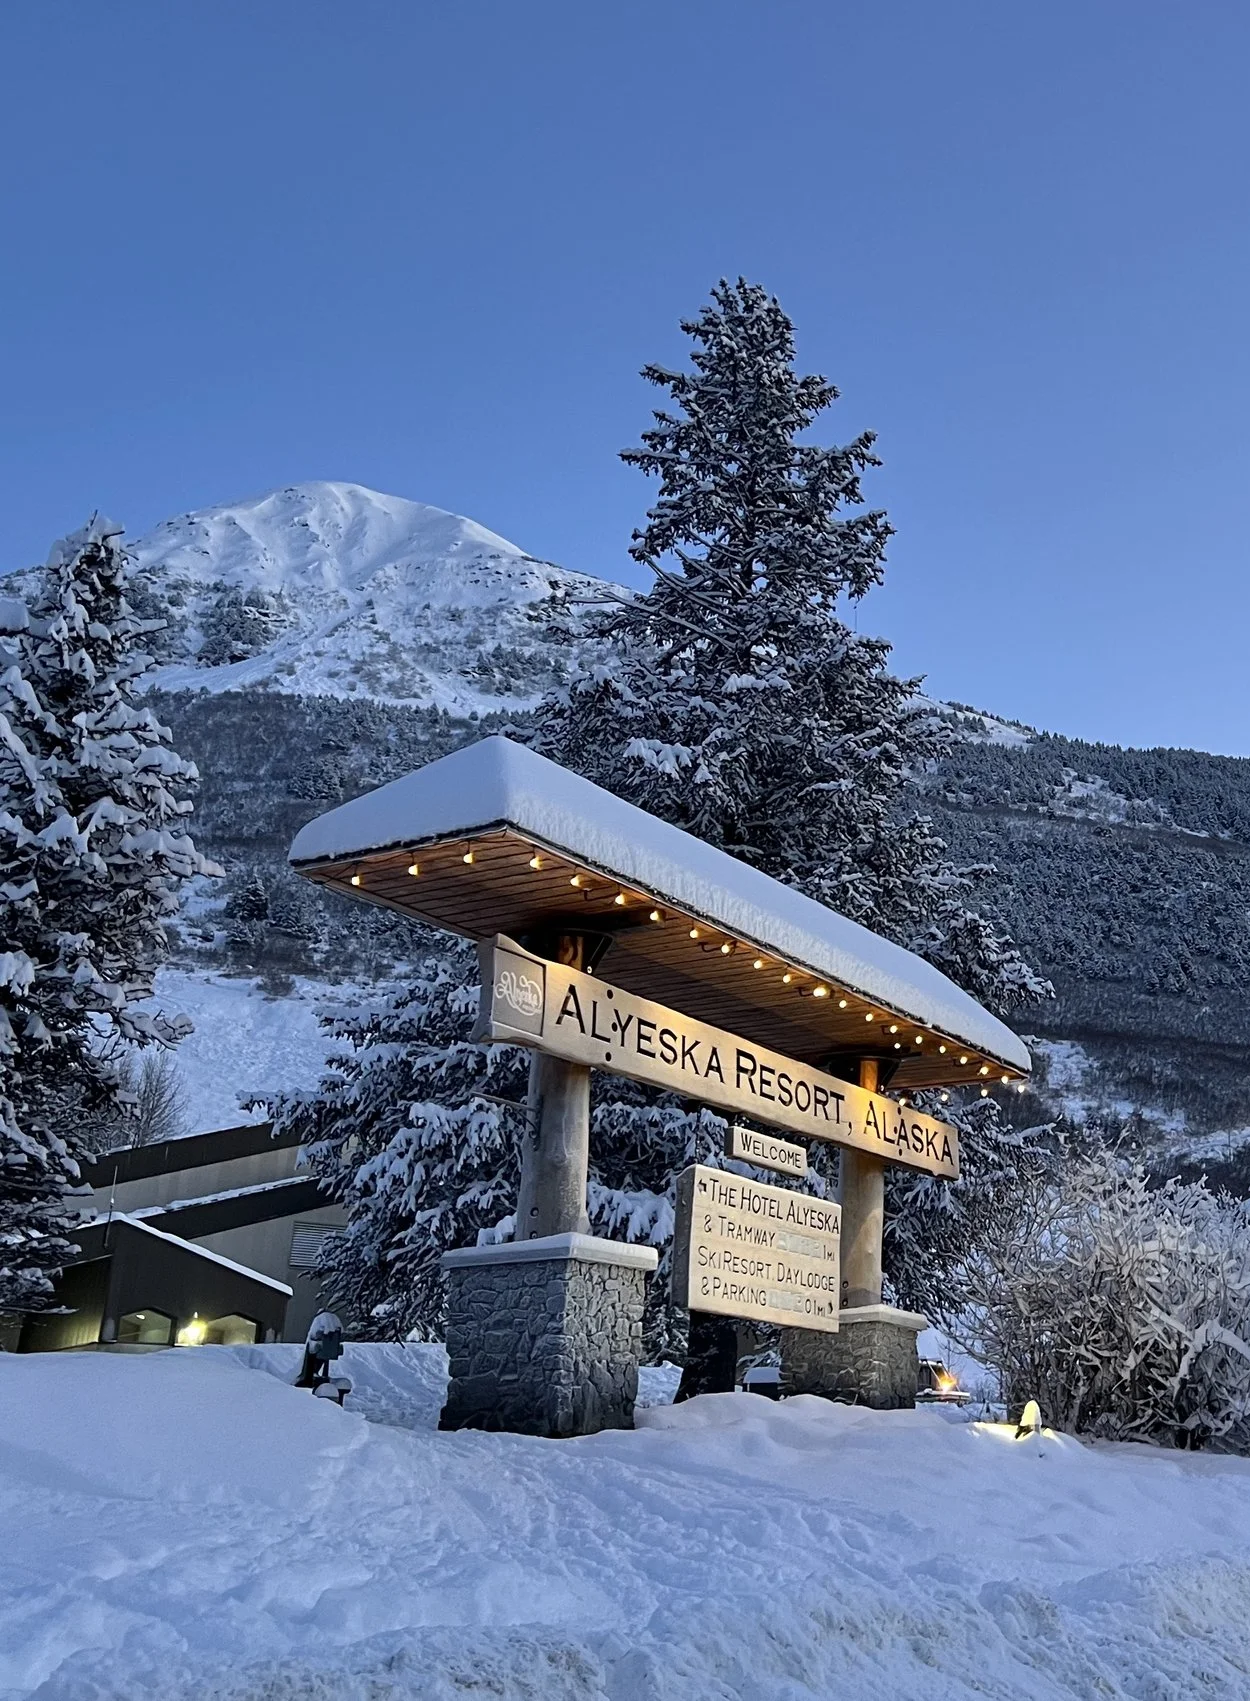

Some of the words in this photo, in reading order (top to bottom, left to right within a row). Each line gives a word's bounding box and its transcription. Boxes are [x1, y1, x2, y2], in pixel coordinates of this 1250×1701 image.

[555, 983, 726, 1085] ALYESKA
[735, 1047, 853, 1136] RESORT,
[863, 1100, 954, 1166] ALASKA
[740, 1132, 802, 1169] WELCOME
[709, 1178, 737, 1208] THE
[740, 1186, 784, 1220] HOTEL
[786, 1200, 840, 1235] ALYESKA
[704, 1214, 712, 1233] &
[718, 1215, 776, 1248] TRAMWAY
[697, 1245, 721, 1270] SKI
[701, 1276, 710, 1296] &
[713, 1277, 767, 1306] PARKING
